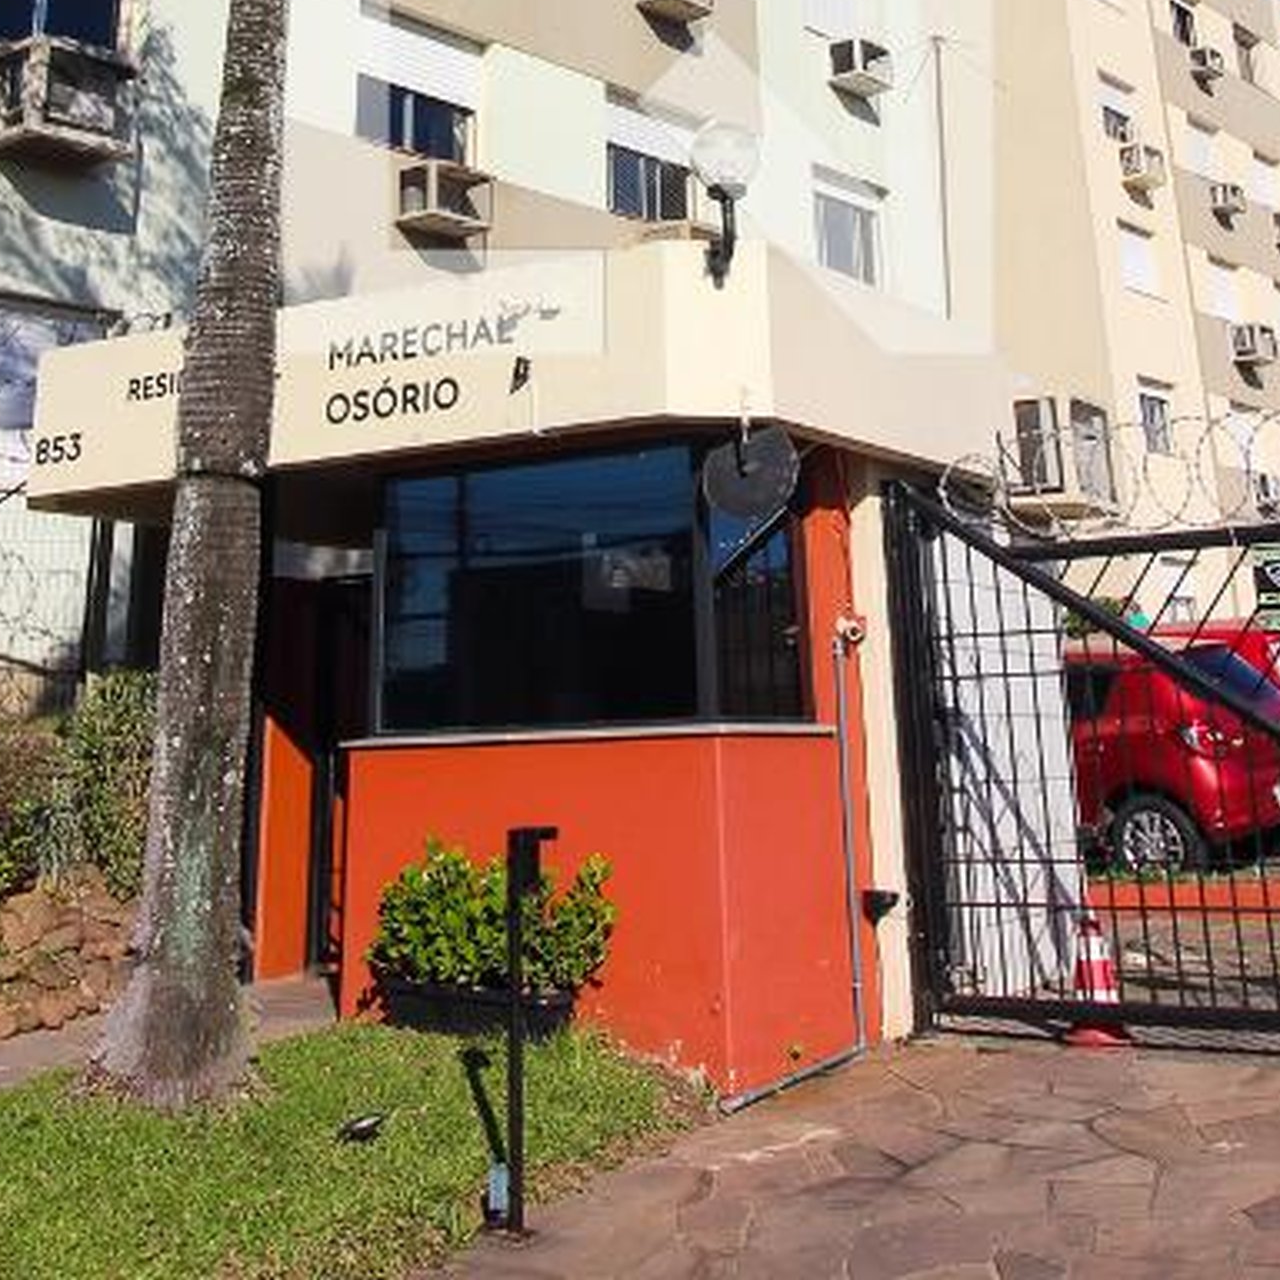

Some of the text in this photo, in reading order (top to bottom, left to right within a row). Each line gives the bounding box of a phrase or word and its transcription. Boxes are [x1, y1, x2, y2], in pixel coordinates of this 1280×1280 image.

[328, 315, 513, 370] MARECHAL
[326, 376, 460, 424] OSÓRIO
[35, 432, 81, 465] 853
